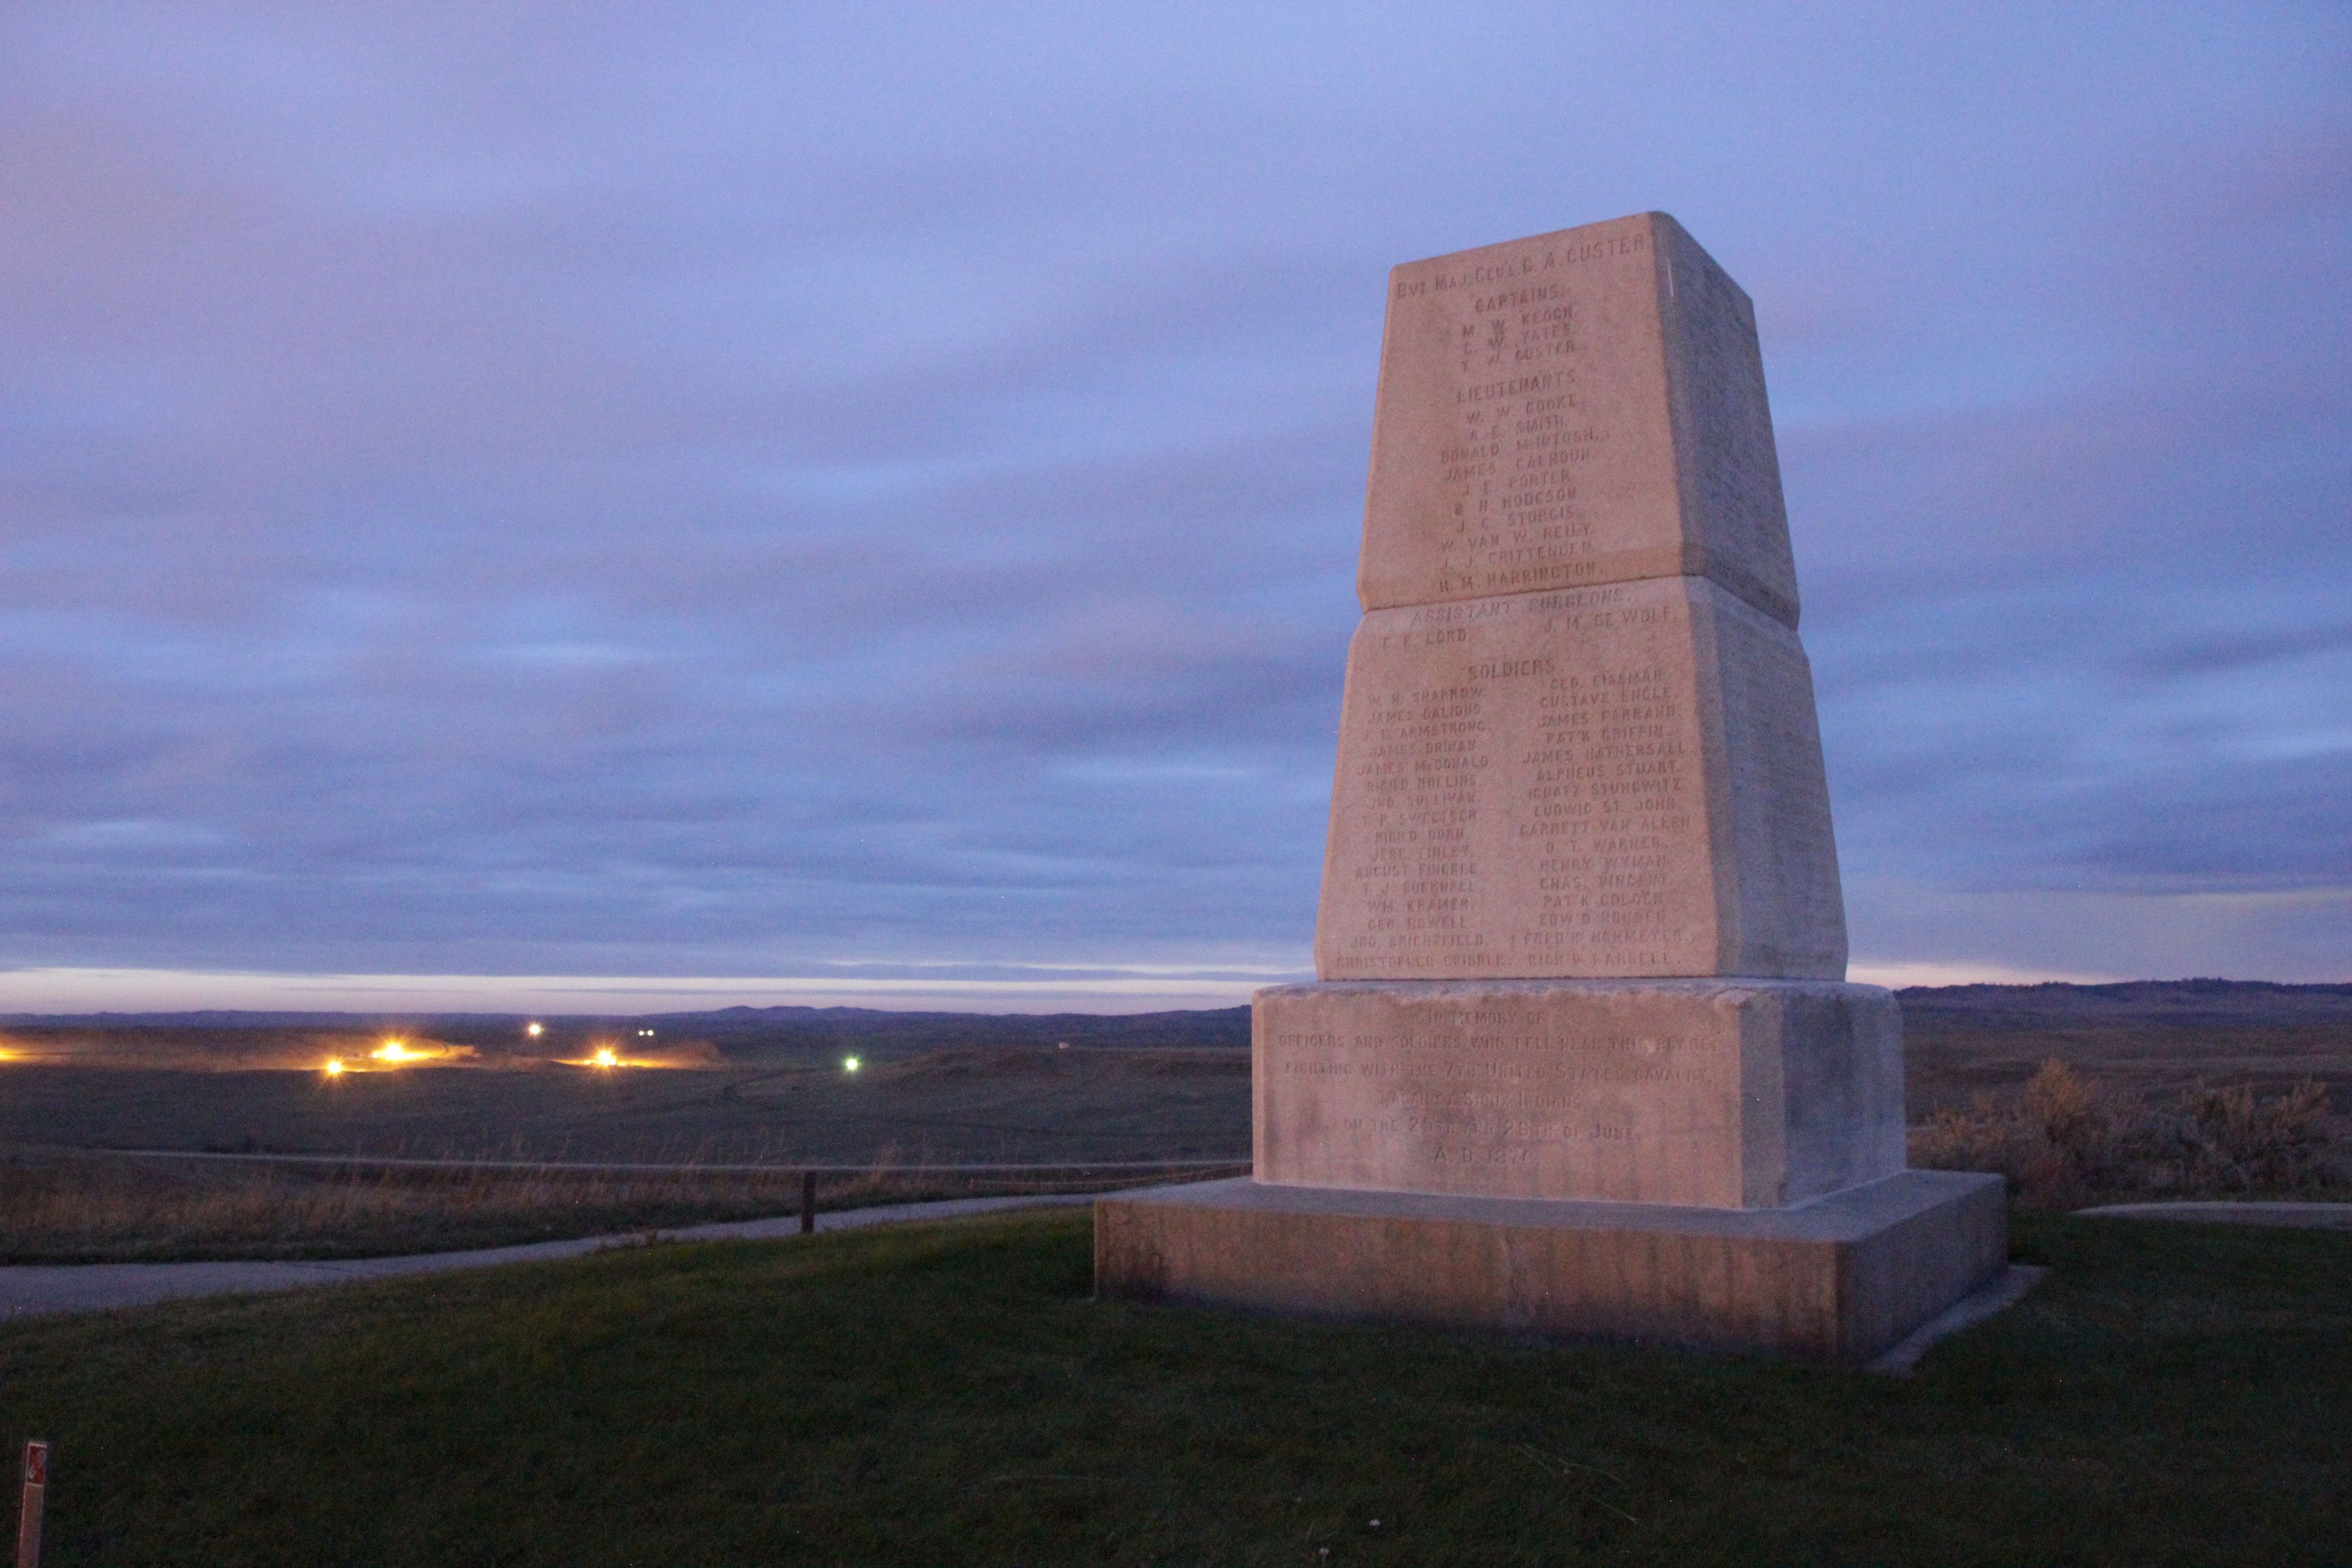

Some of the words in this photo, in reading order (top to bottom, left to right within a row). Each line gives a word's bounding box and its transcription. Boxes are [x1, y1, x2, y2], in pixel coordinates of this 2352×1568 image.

[1440, 442, 1500, 466] DONALD
[1445, 461, 1498, 483] JAMES
[1468, 533, 1500, 551] VAN
[1411, 601, 1512, 625] ASSISTANT
[1540, 692, 1610, 709] GUSTAVE
[1368, 709, 1414, 725] JAMES
[1538, 711, 1590, 728] JAMES
[1368, 742, 1415, 758] JAMES
[1522, 748, 1574, 764] JAMES
[1357, 761, 1405, 777] JAMES
[1536, 764, 1606, 782] ALPHEUS
[1519, 820, 1590, 837] GARRETT
[1600, 816, 1632, 832] VAN
[1355, 863, 1409, 880] AUGUST
[1539, 856, 1593, 872] HENRY
[1453, 1009, 1517, 1025] MEMORY
[1526, 1011, 1544, 1024] OF
[1279, 1034, 1344, 1048] OFFICERS
[1355, 1035, 1382, 1049] AND
[1360, 1062, 1401, 1076] WITH
